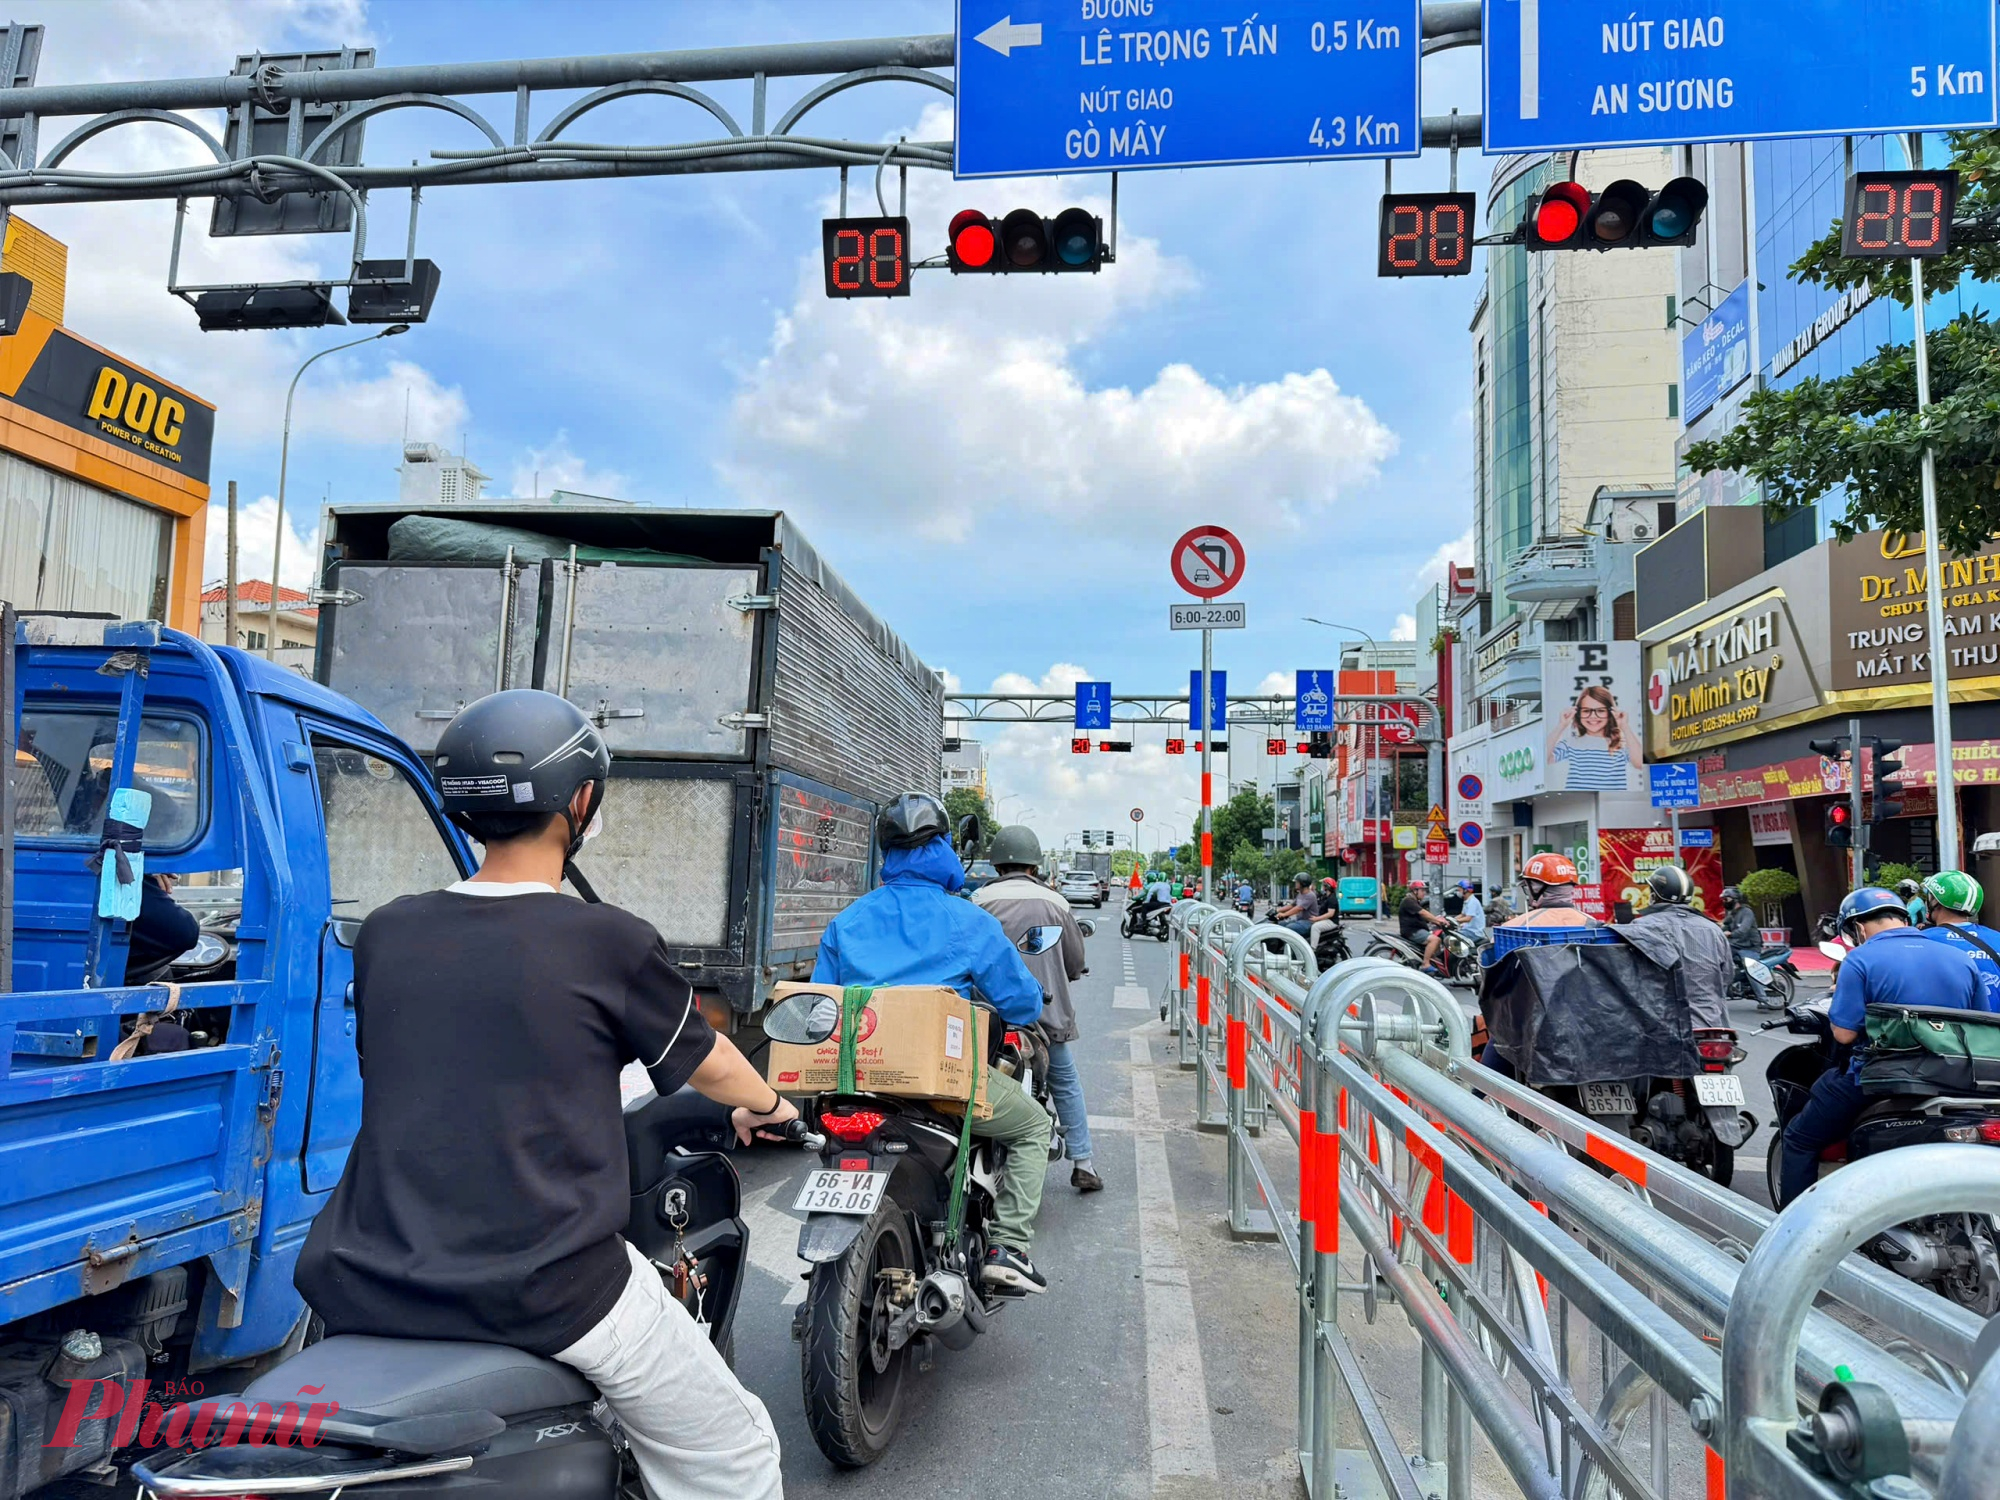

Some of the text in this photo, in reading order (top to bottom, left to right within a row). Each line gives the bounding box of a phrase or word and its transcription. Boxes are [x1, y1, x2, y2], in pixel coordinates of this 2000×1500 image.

[1080, 12, 1277, 67] LÊ TRỌNG TẤN
[1311, 18, 1400, 54] 0,5 Km
[1602, 11, 1724, 54] NÚT GIAO
[1911, 63, 1984, 98] 5 Km
[1080, 85, 1173, 114] NÚT GIAO
[1590, 77, 1734, 116] AN SƯƠNG
[1065, 119, 1167, 159] GÒ MÂY
[1308, 114, 1400, 150] 4,3 Km
[1856, 183, 1942, 248] 20
[1388, 204, 1465, 268] 20
[832, 228, 902, 289] 20
[1721, 319, 1746, 348] DECAL
[1772, 340, 1795, 378] MINH
[1814, 294, 1849, 340] GROUP
[101, 421, 182, 463] POWER OF CREATION
[1175, 609, 1241, 624] 6:00-22:00
[1880, 596, 1948, 618] CHUYN
[1952, 591, 1985, 607] GIA
[1847, 623, 1925, 650] TRUNG
[1943, 614, 1982, 638] ÂM
[1578, 643, 1608, 672] E
[1667, 611, 1774, 687] MẮT KÍNH
[1856, 647, 1905, 679] MẮT
[1573, 676, 1590, 691] F
[1073, 739, 1089, 753] 20
[1167, 739, 1183, 753] 20
[1268, 740, 1286, 754] 20
[1923, 768, 1979, 783] TNG
[1673, 798, 1693, 806] CAMERA
[1930, 879, 1946, 895] Grab
[1885, 1119, 1927, 1129] VISION
[815, 1172, 875, 1191] 66-VA
[804, 1190, 874, 1210] 136.06
[535, 1421, 587, 1444] RSX
